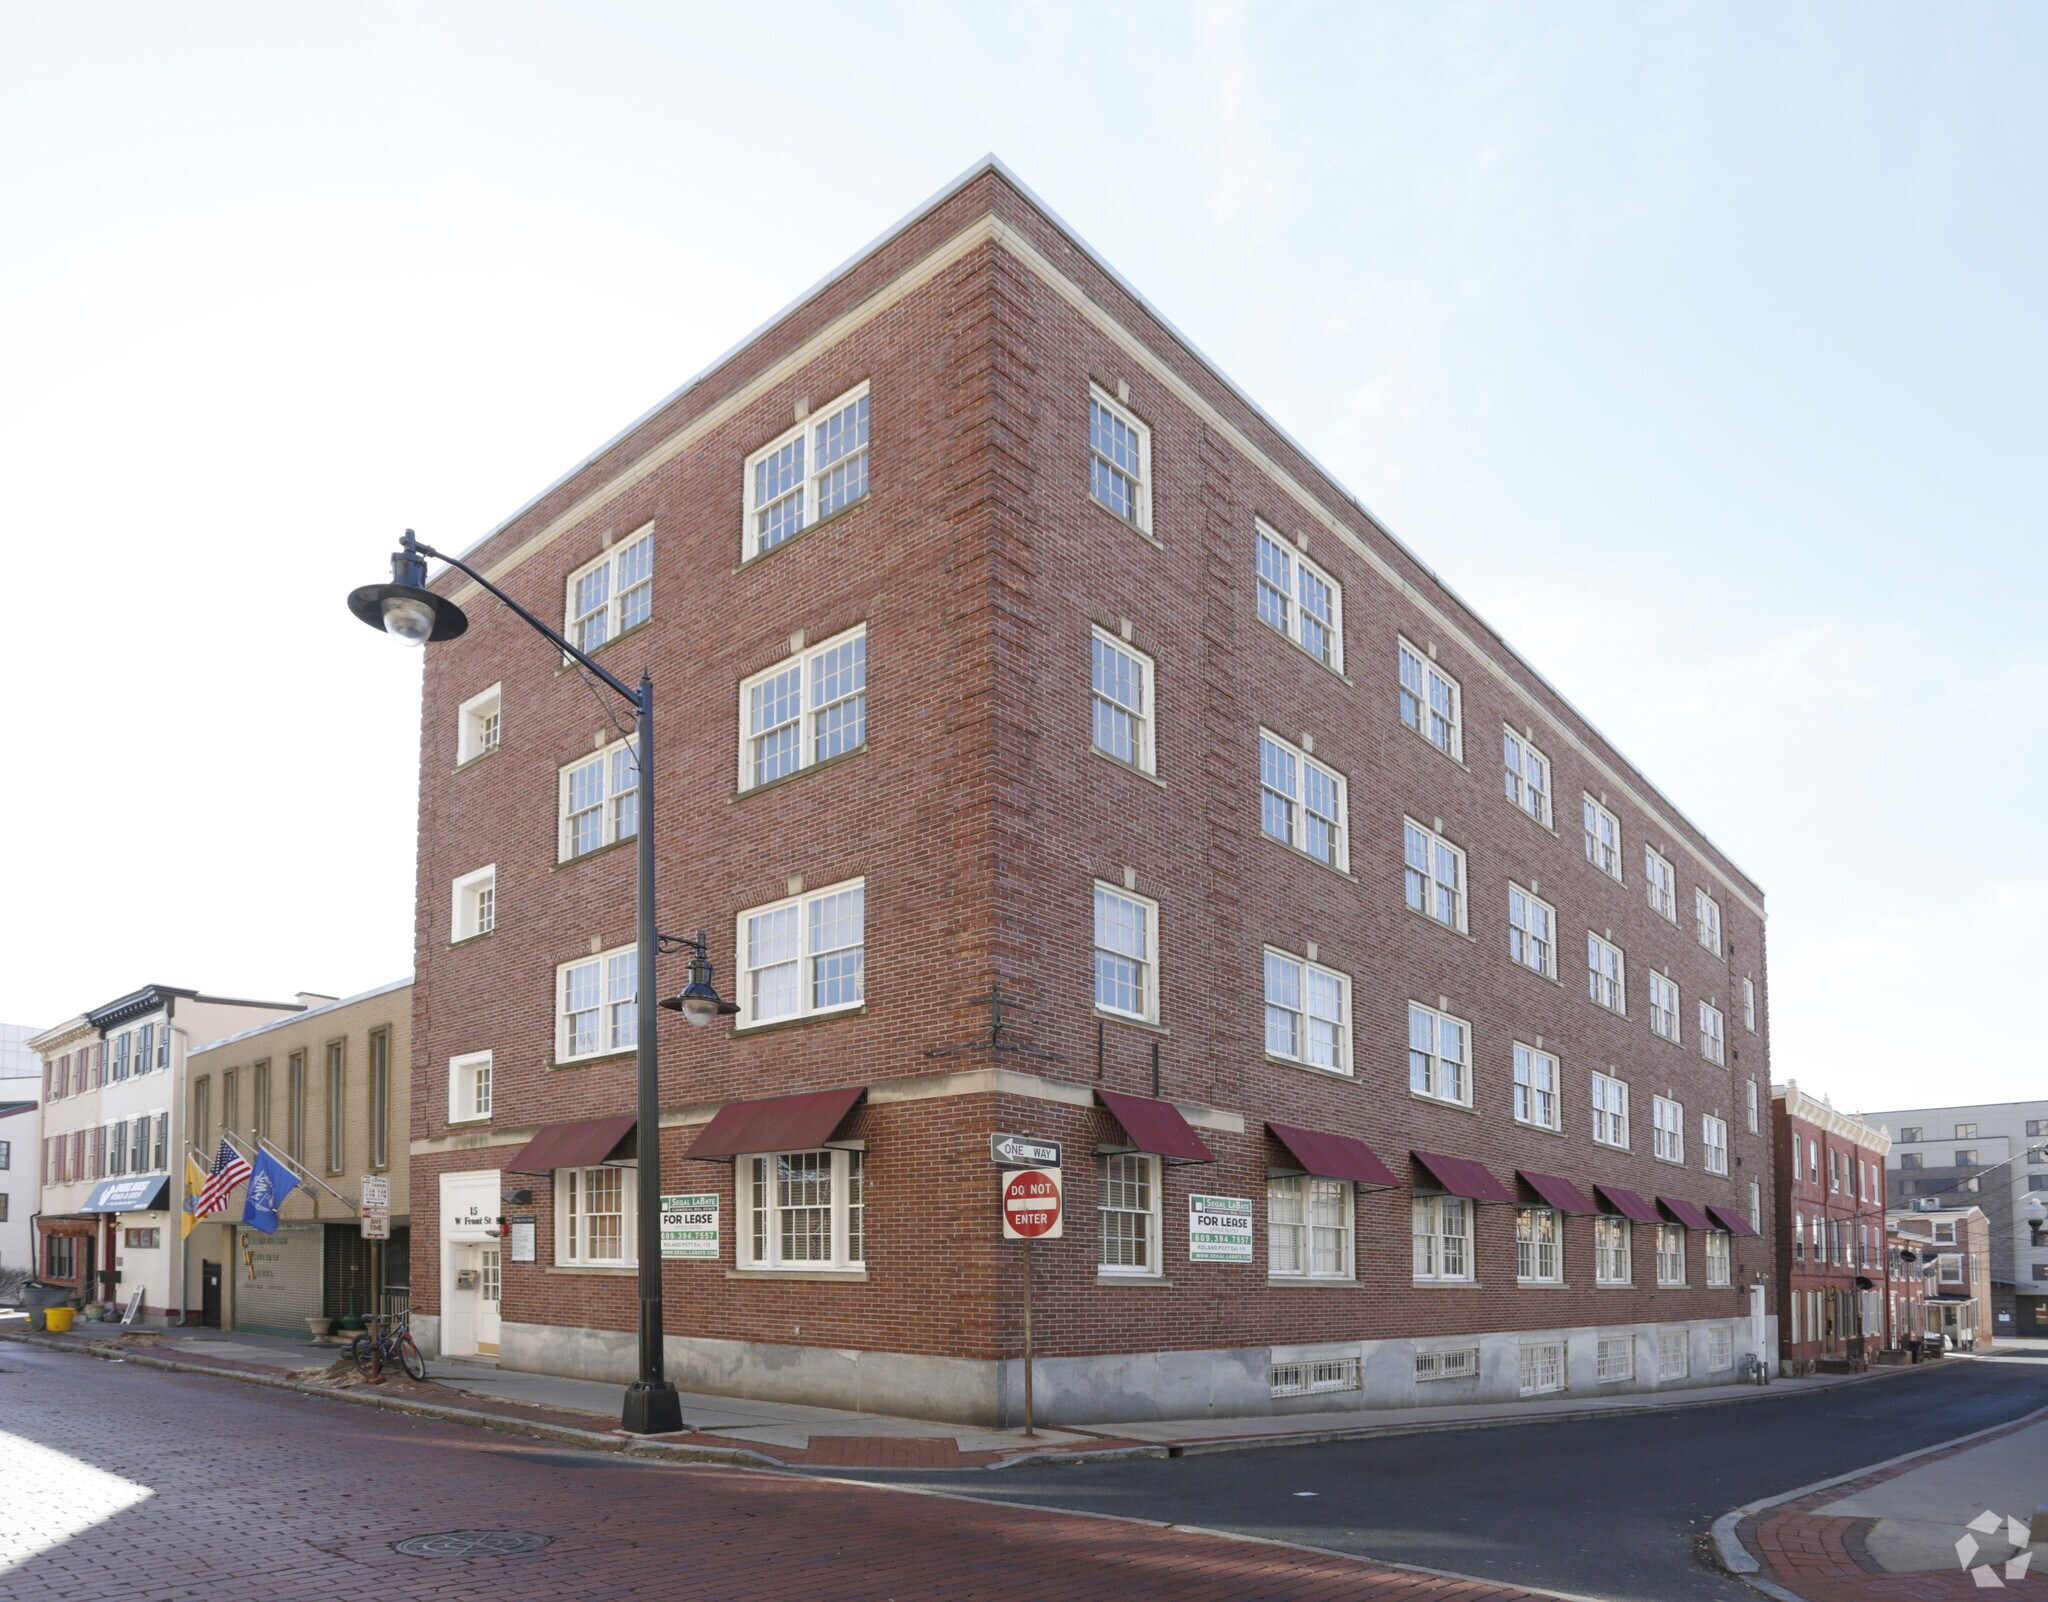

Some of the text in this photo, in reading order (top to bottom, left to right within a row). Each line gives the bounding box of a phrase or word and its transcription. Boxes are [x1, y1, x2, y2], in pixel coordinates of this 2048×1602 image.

[1004, 1143, 1051, 1159] ONE WAY
[1011, 1183, 1052, 1196] DO NOT
[671, 1198, 690, 1206] SEGAL
[1206, 1199, 1226, 1208] SEGAL
[470, 1206, 478, 1216] 15
[454, 1216, 492, 1225] W Front St
[663, 1213, 713, 1224] FOR LEASE
[1015, 1213, 1048, 1225] ENTER
[1198, 1216, 1248, 1228] FOR LEASE
[661, 1232, 714, 1240] 609.394.7557
[1194, 1233, 1249, 1244] 609.394.7557
